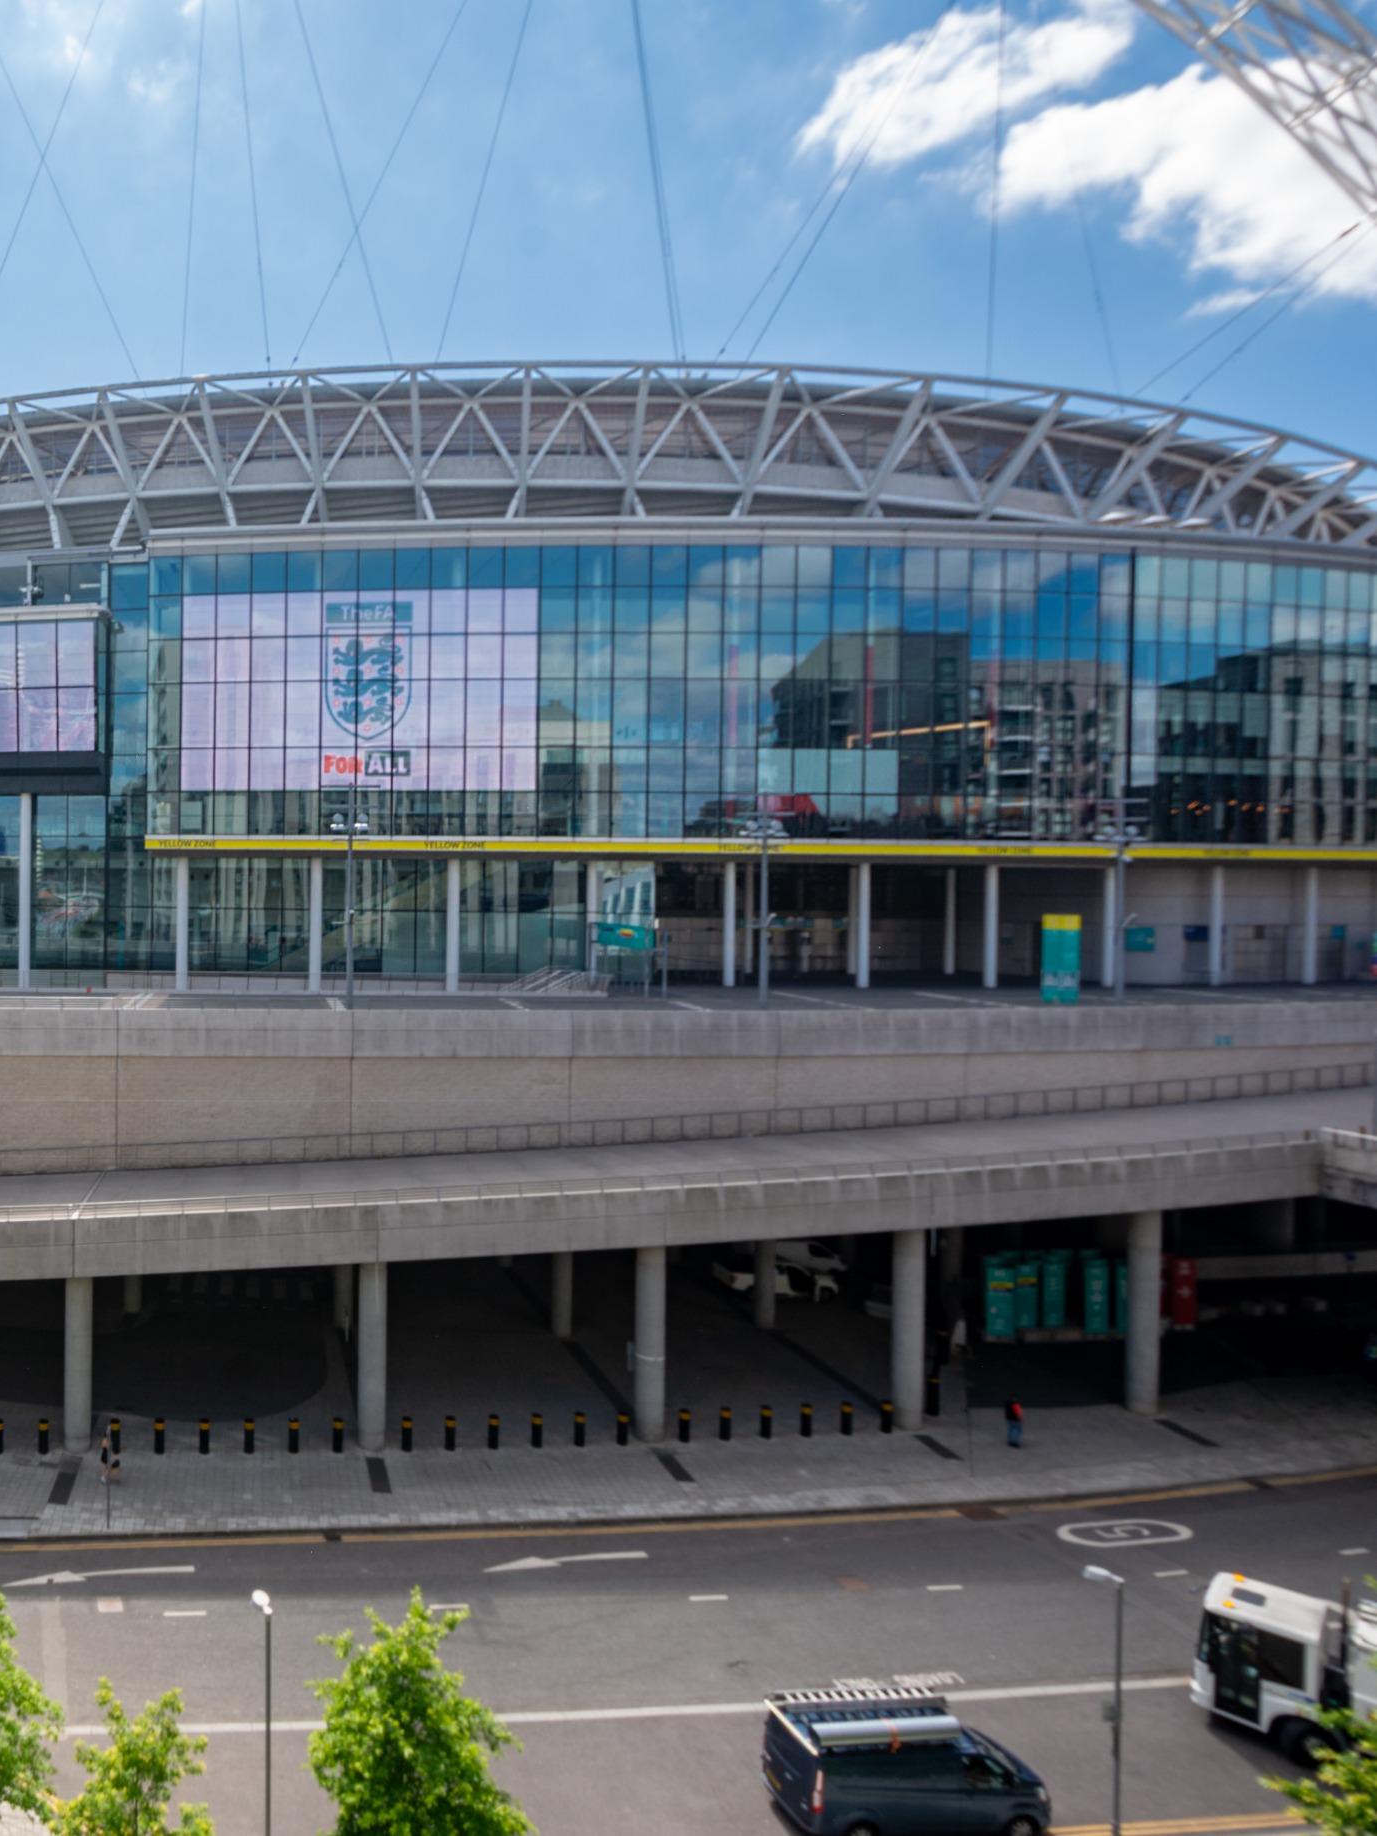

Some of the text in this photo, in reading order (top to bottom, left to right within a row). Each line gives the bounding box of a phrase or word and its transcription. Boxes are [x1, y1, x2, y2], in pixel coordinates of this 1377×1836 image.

[323, 754, 408, 775] FOR ALL
[158, 840, 216, 849] YELLOW ZONE
[424, 840, 486, 849] YELLOW ZONE
